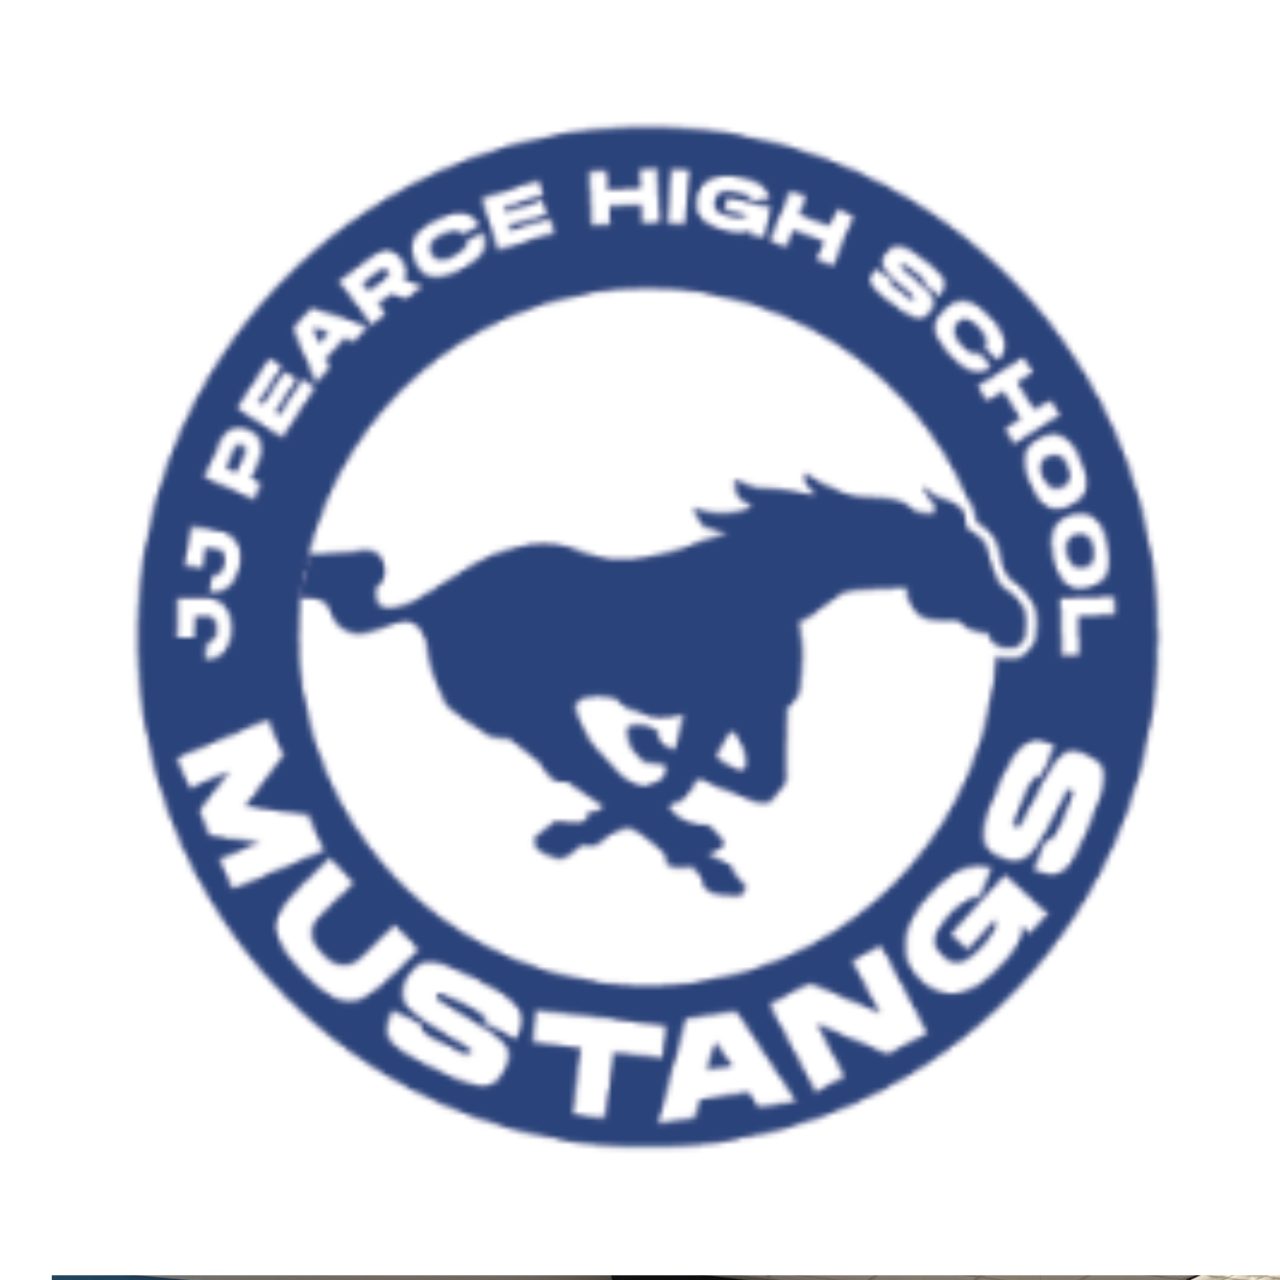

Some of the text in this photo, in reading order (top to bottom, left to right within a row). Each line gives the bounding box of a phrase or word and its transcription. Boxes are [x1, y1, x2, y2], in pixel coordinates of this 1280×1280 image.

[206, 182, 553, 498] PEARCE
[590, 169, 852, 264] HIGH
[177, 528, 240, 658] JJ
[870, 247, 1115, 655] SCHOOL
[178, 721, 1104, 1122] MUSTANGS
